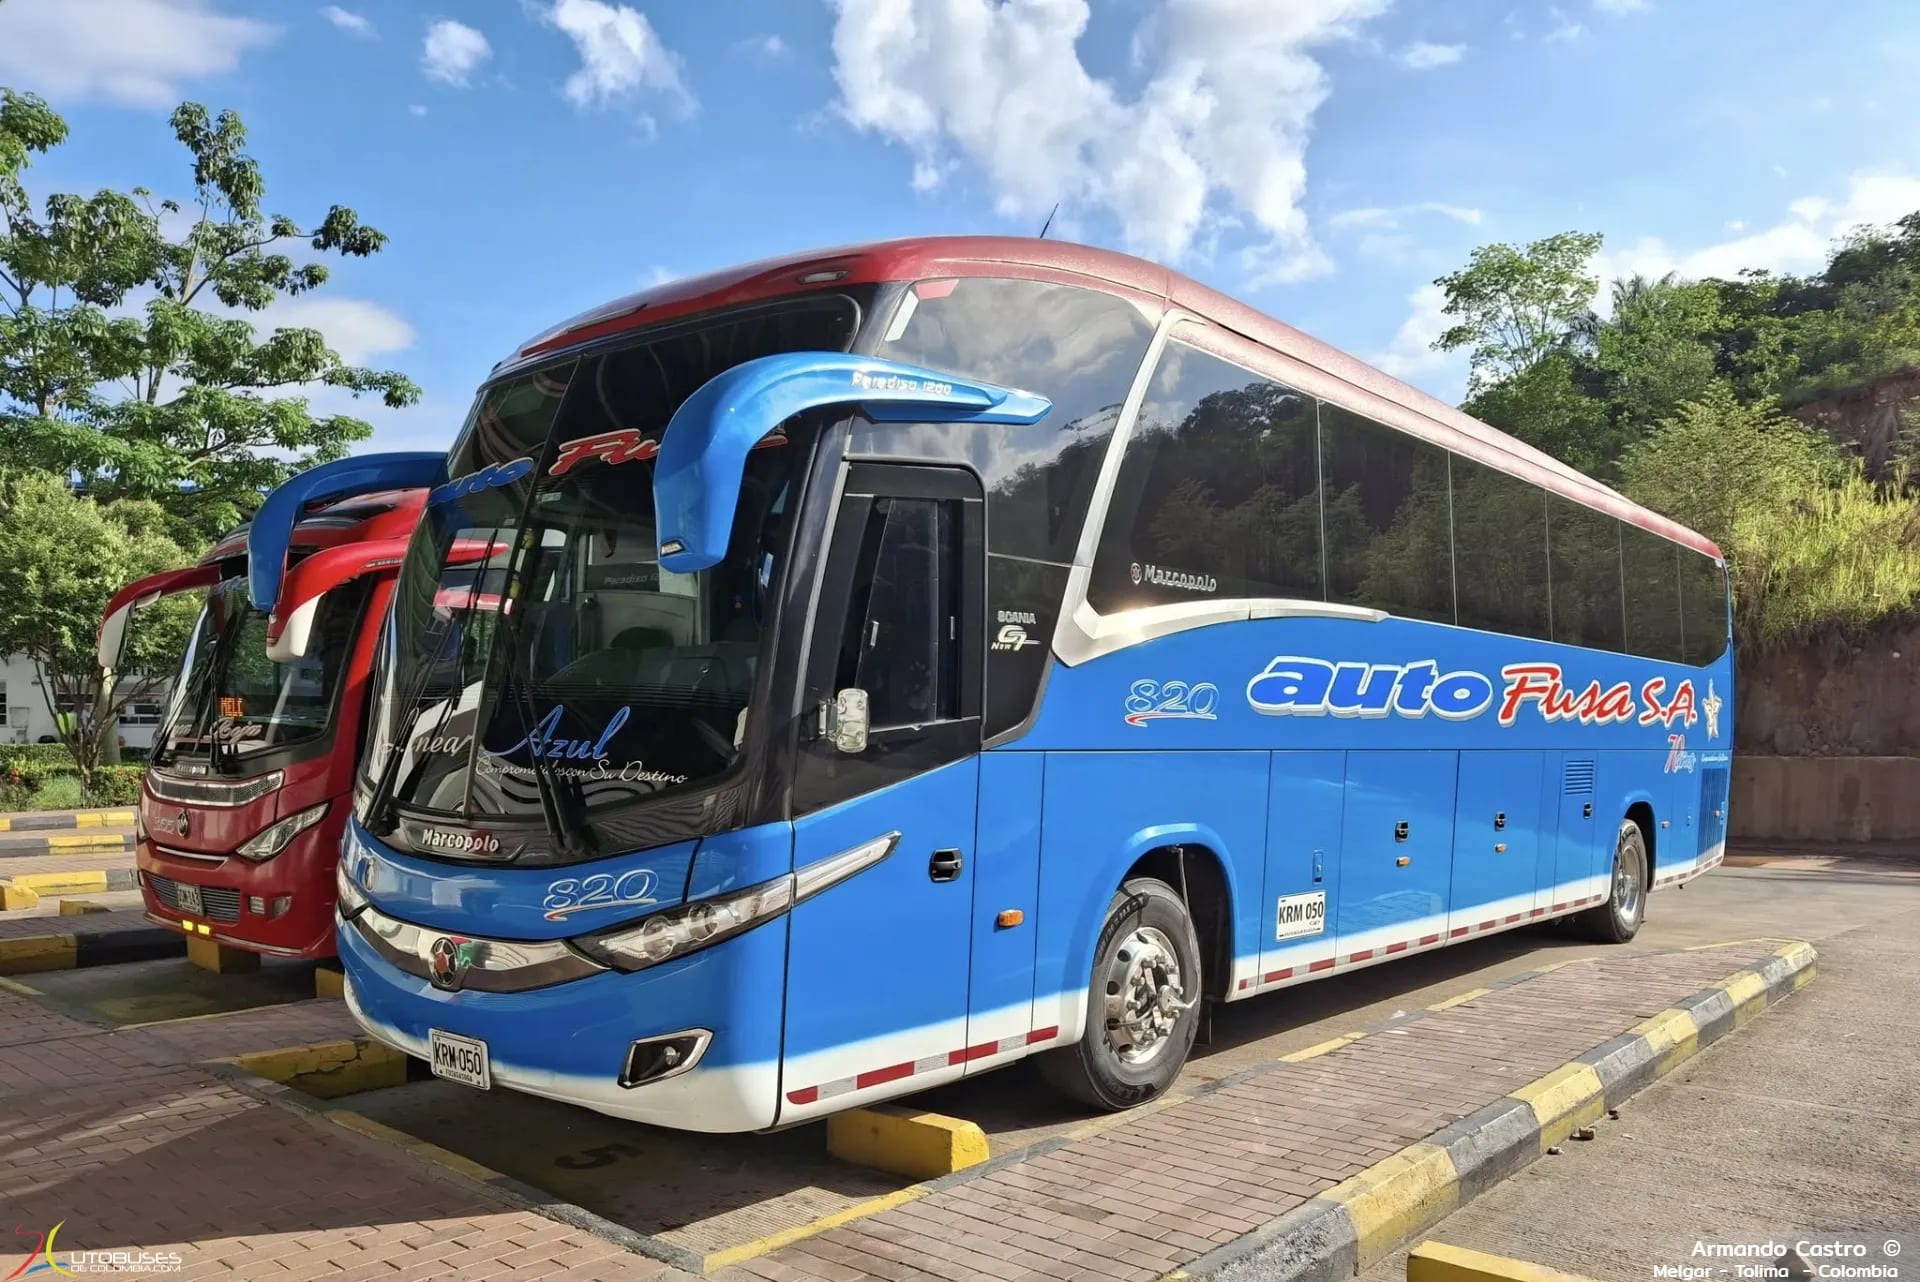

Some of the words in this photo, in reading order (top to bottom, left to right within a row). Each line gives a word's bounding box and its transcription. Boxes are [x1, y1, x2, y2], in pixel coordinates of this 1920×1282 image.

[1144, 564, 1217, 592] Marcopolo
[997, 611, 1037, 625] SCANIA
[1125, 678, 1220, 715] 820
[1246, 656, 1493, 720] auto
[1497, 662, 1634, 727] Fusa
[1639, 676, 1698, 730] S.A.
[481, 704, 631, 760] Azul
[590, 759, 617, 779] Su
[619, 760, 688, 784] Destino
[421, 828, 499, 852] Marcopolo
[543, 869, 660, 911] 820
[1278, 903, 1303, 925] KRM
[1305, 901, 1324, 920] 050
[434, 1041, 457, 1070] KRM
[458, 1047, 482, 1076] 050
